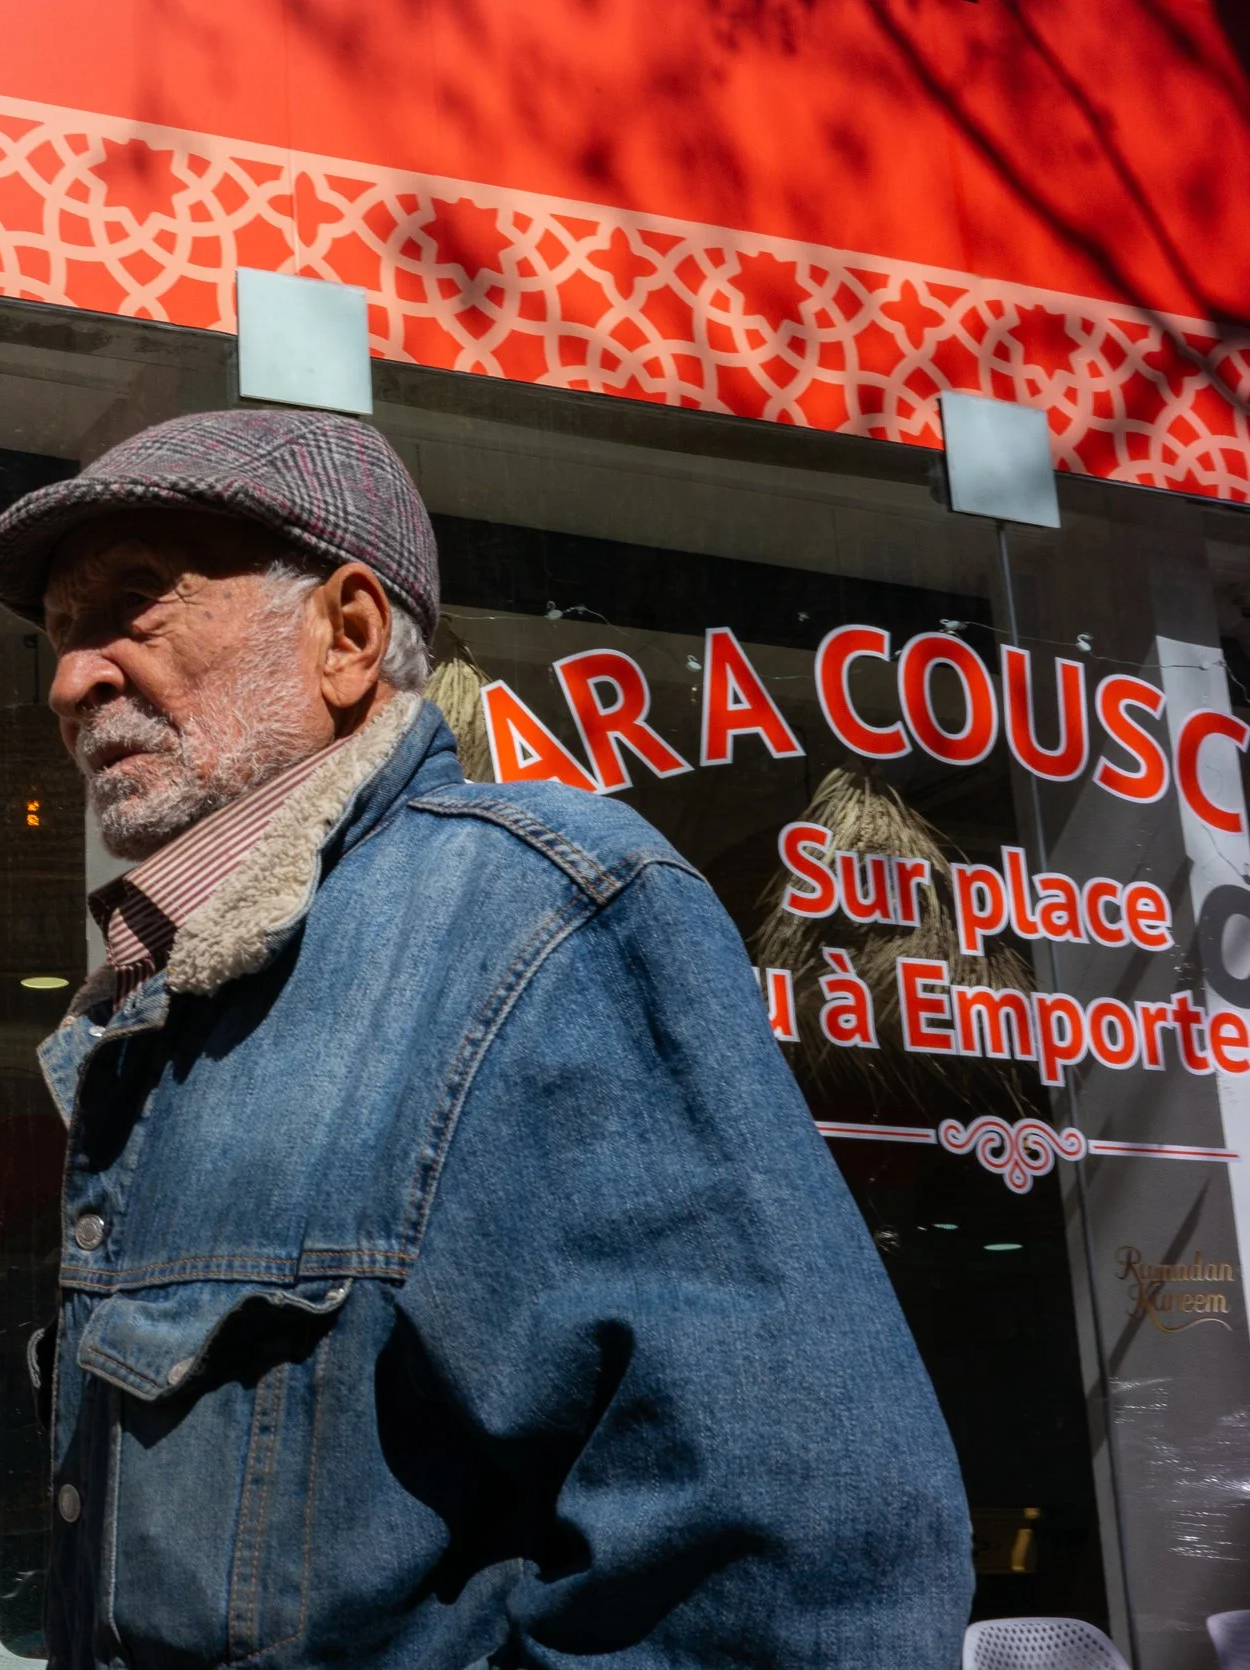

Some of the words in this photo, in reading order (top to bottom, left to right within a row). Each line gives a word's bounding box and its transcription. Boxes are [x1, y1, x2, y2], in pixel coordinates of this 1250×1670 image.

[814, 624, 1250, 833] COUSC
[778, 821, 931, 927] Sur
[950, 845, 1177, 957] place
[818, 947, 880, 1049] à
[897, 957, 1250, 1087] Emporte
